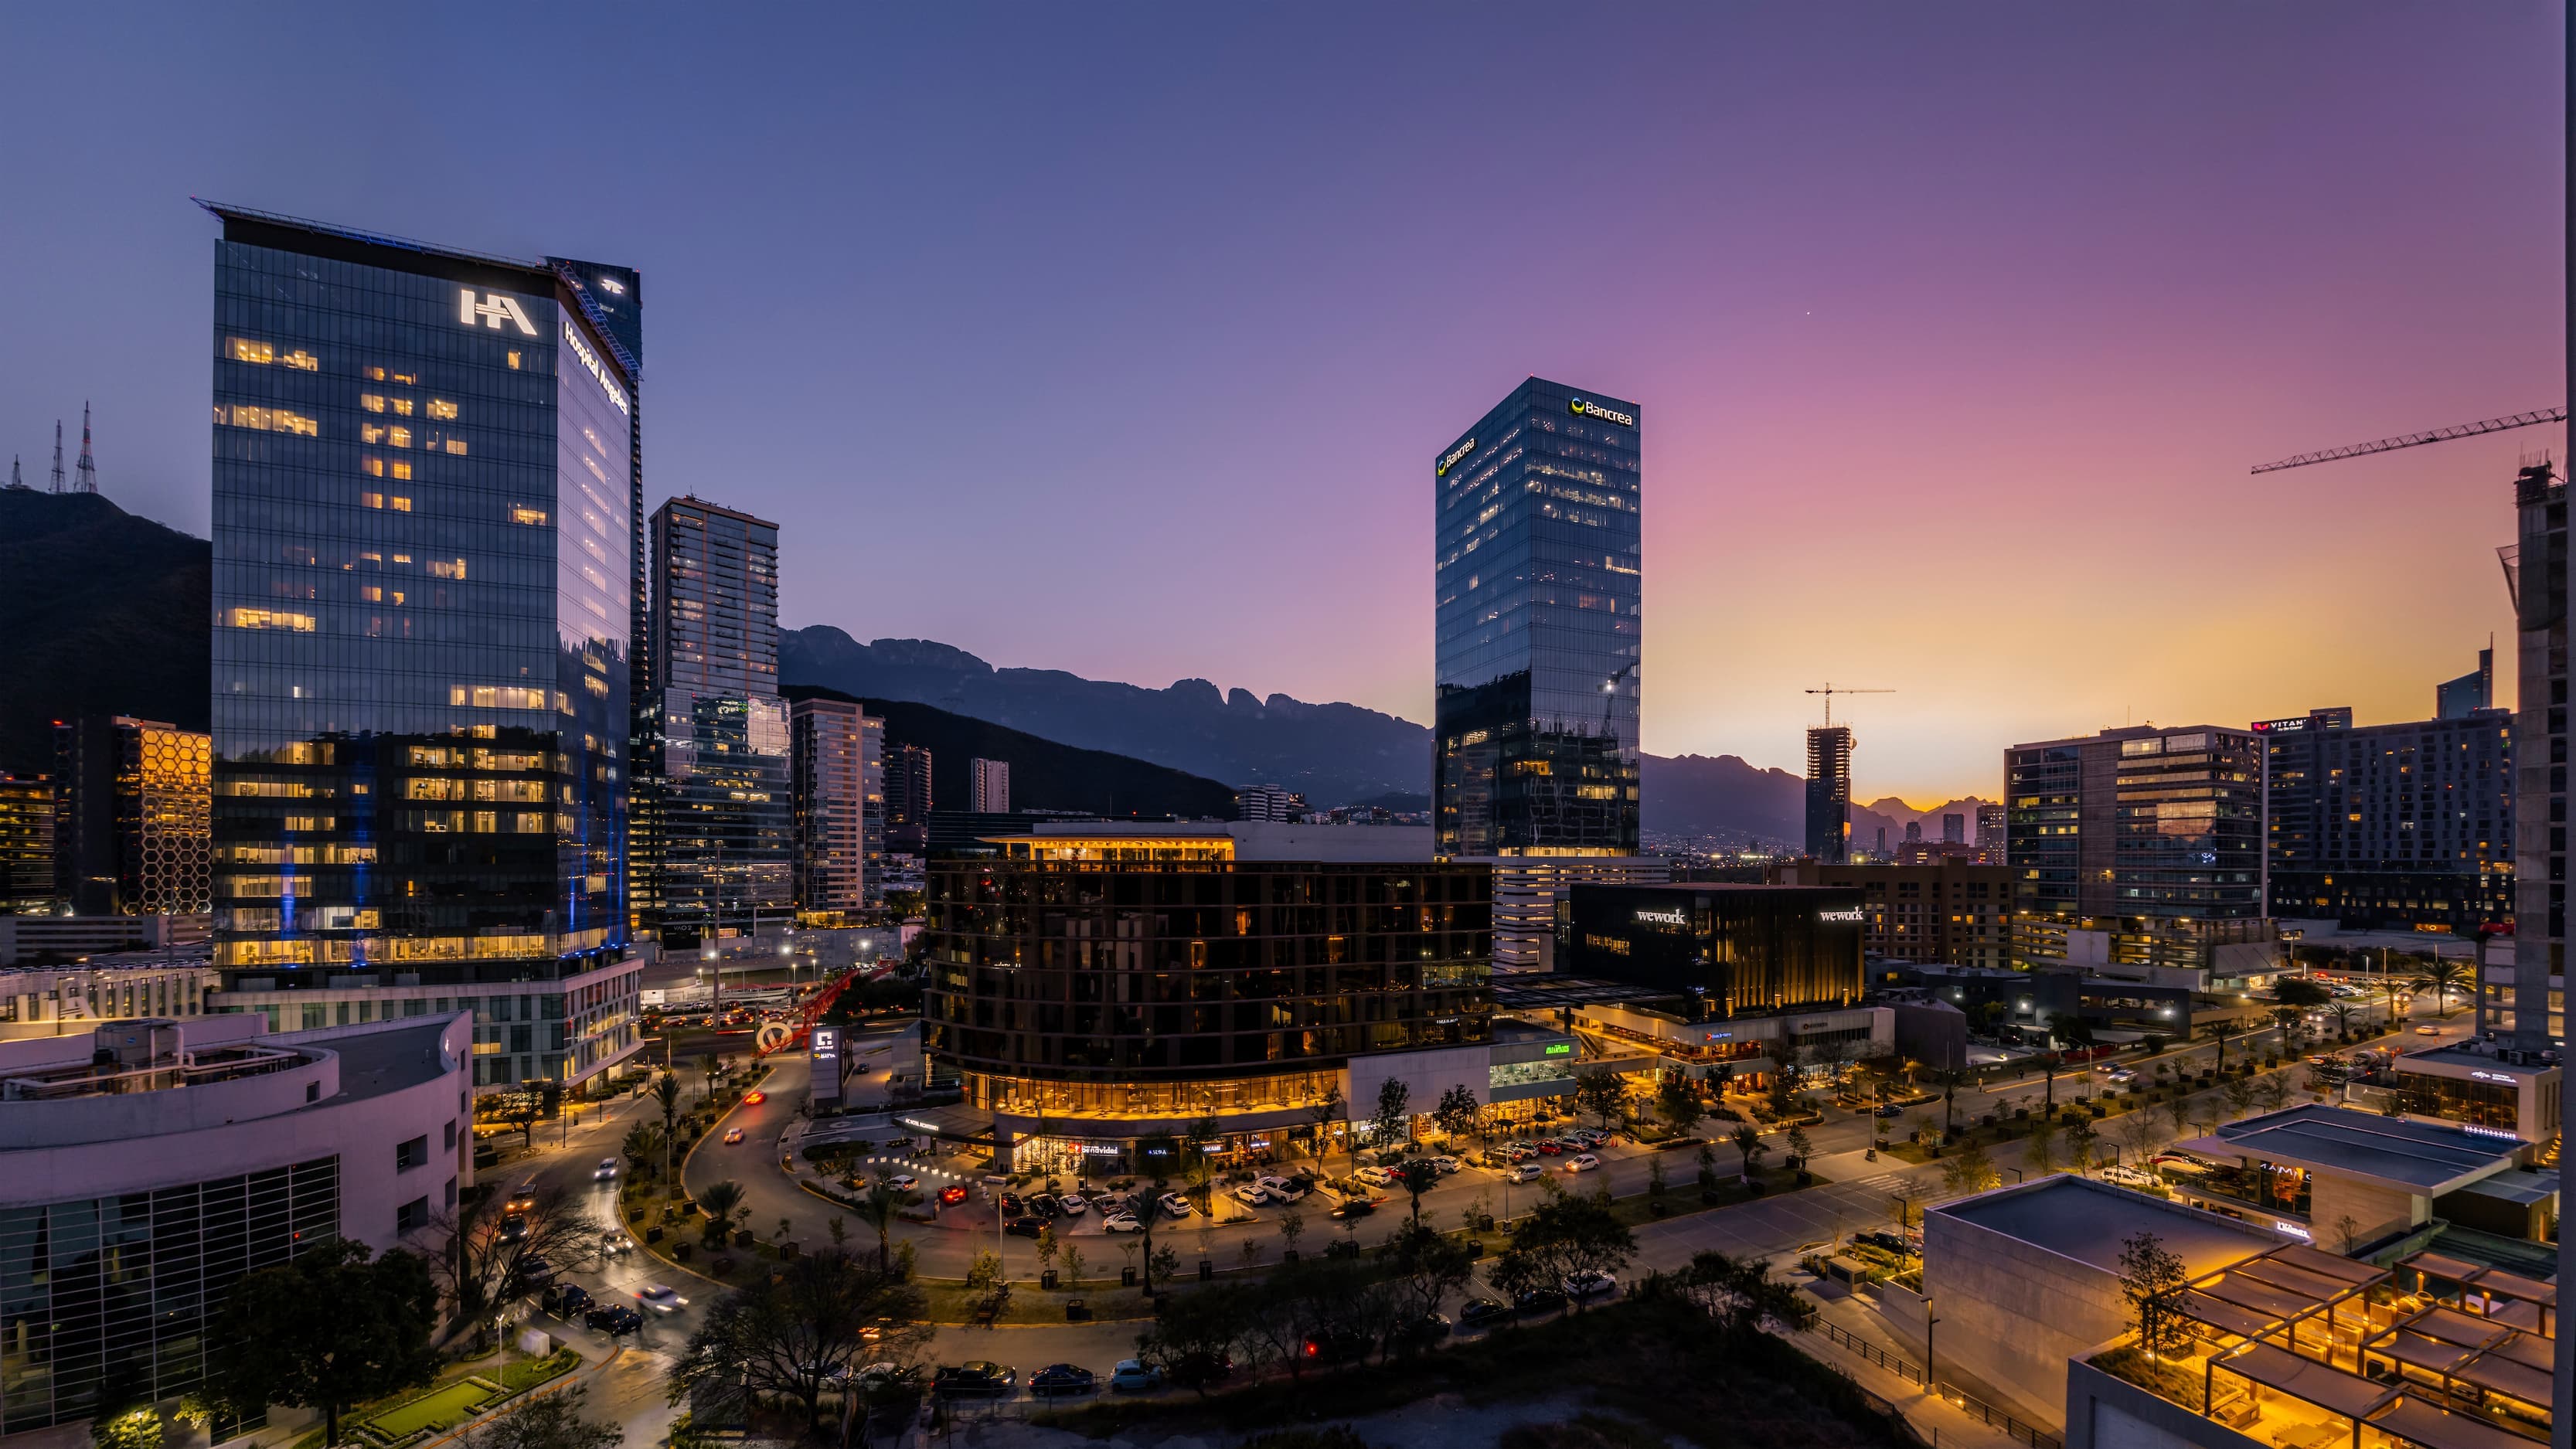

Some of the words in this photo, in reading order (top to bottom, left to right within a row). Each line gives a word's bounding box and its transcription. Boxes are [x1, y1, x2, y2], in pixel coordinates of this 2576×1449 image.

[564, 321, 599, 377] Hospital
[599, 369, 628, 415] Angeles
[1585, 401, 1632, 426] Bancrea
[1446, 437, 1475, 468] Bancrea
[1637, 909, 1686, 924] wework
[1819, 906, 1863, 921] wework
